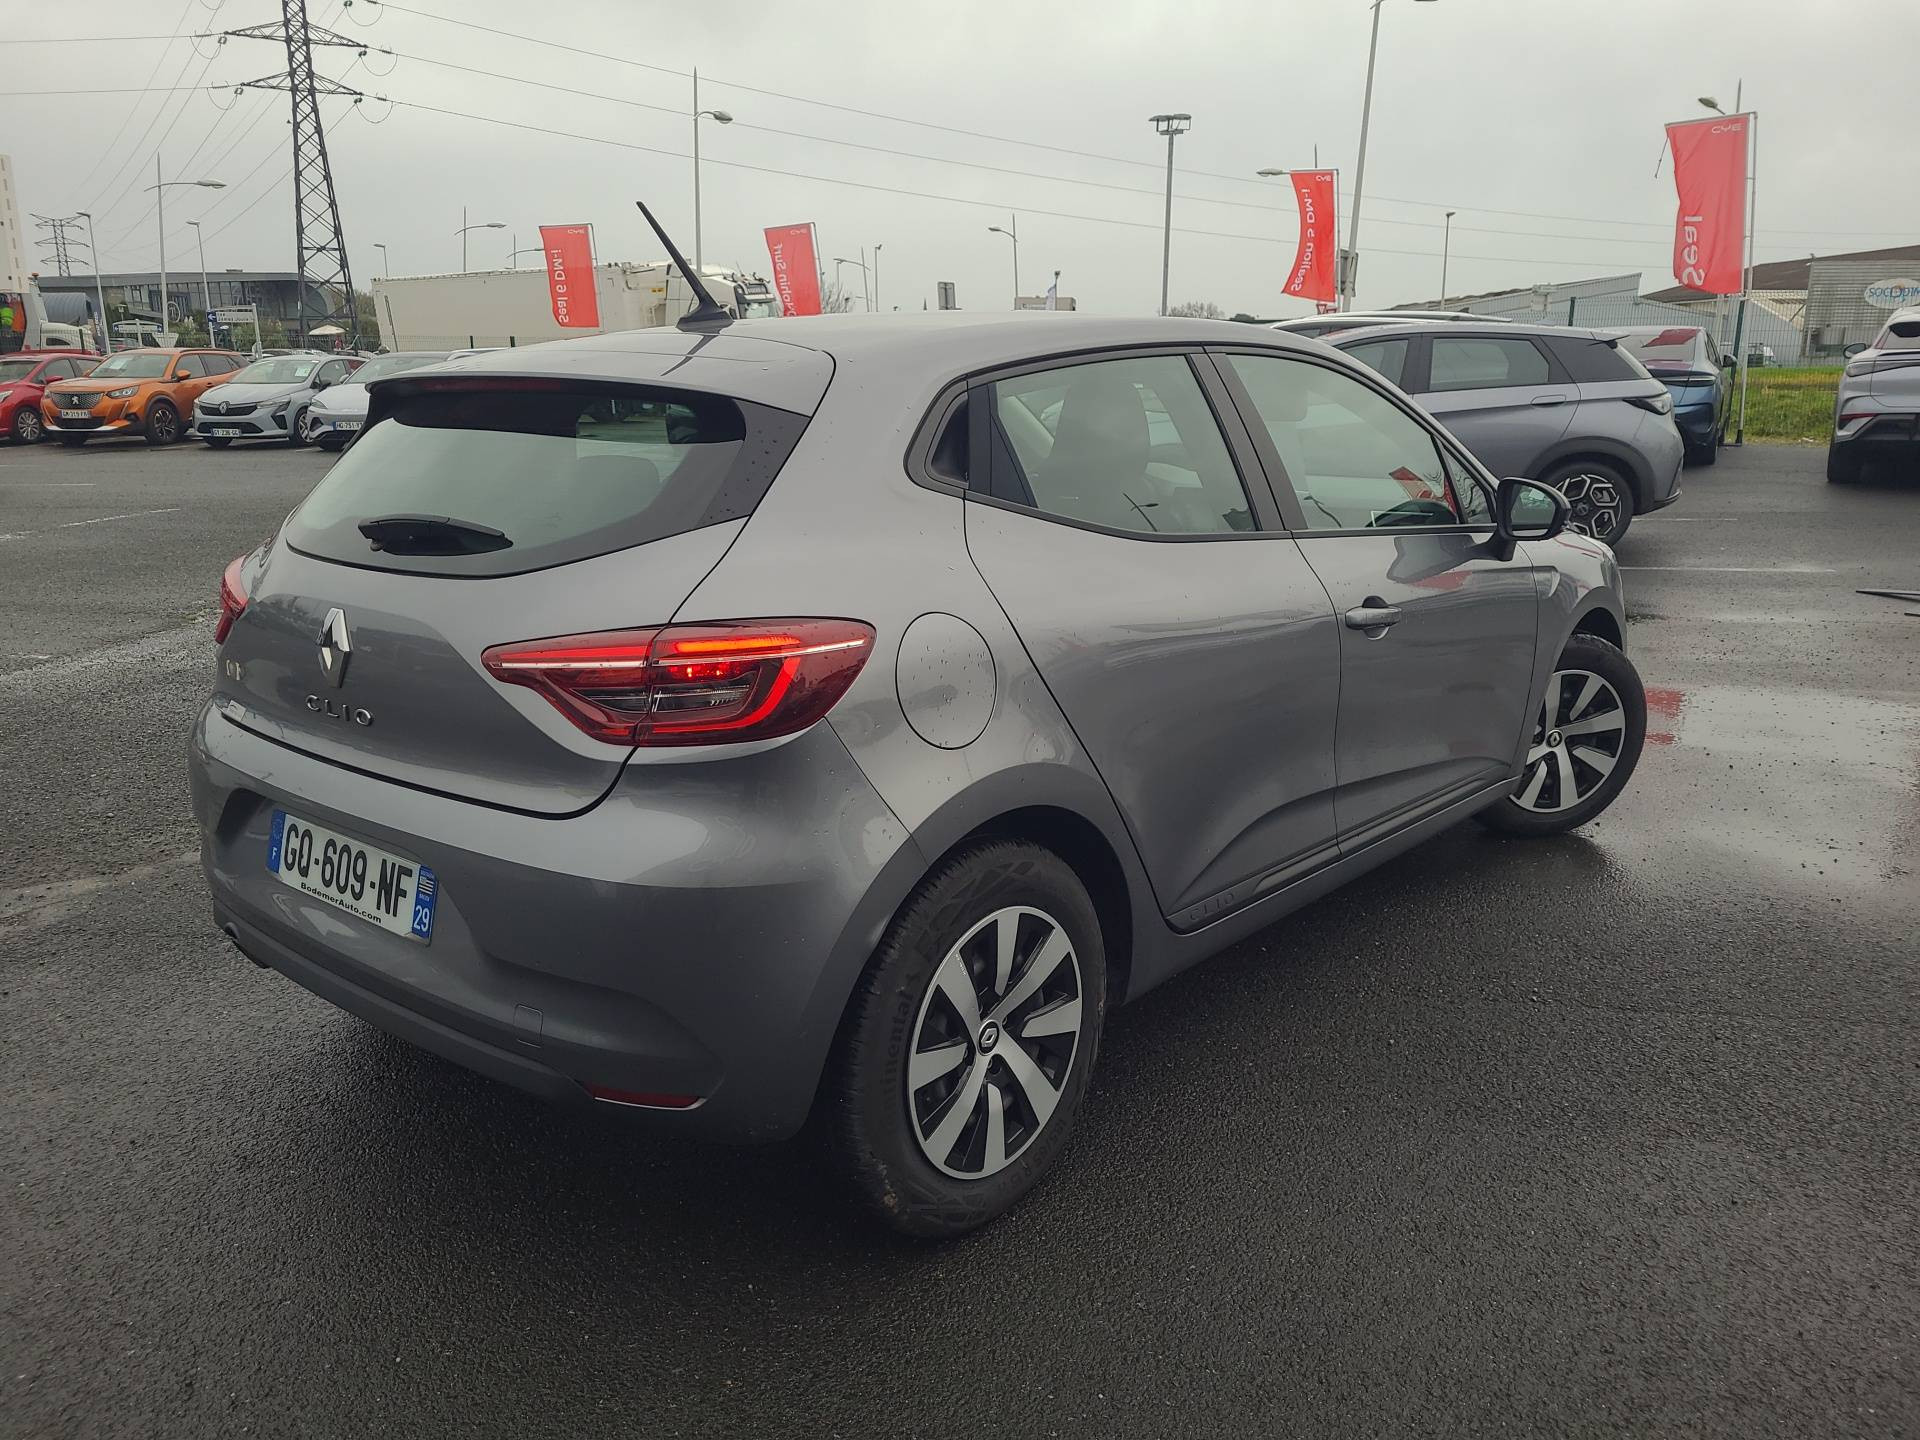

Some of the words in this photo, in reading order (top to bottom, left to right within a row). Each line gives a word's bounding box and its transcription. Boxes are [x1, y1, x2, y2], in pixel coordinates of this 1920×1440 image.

[305, 694, 373, 726] CLIO
[271, 847, 278, 860] F
[284, 823, 413, 917] GQ-609-NF
[300, 882, 382, 924] BodemerAuto.com
[413, 905, 430, 931] 29
[1189, 893, 1234, 922] CLIO
